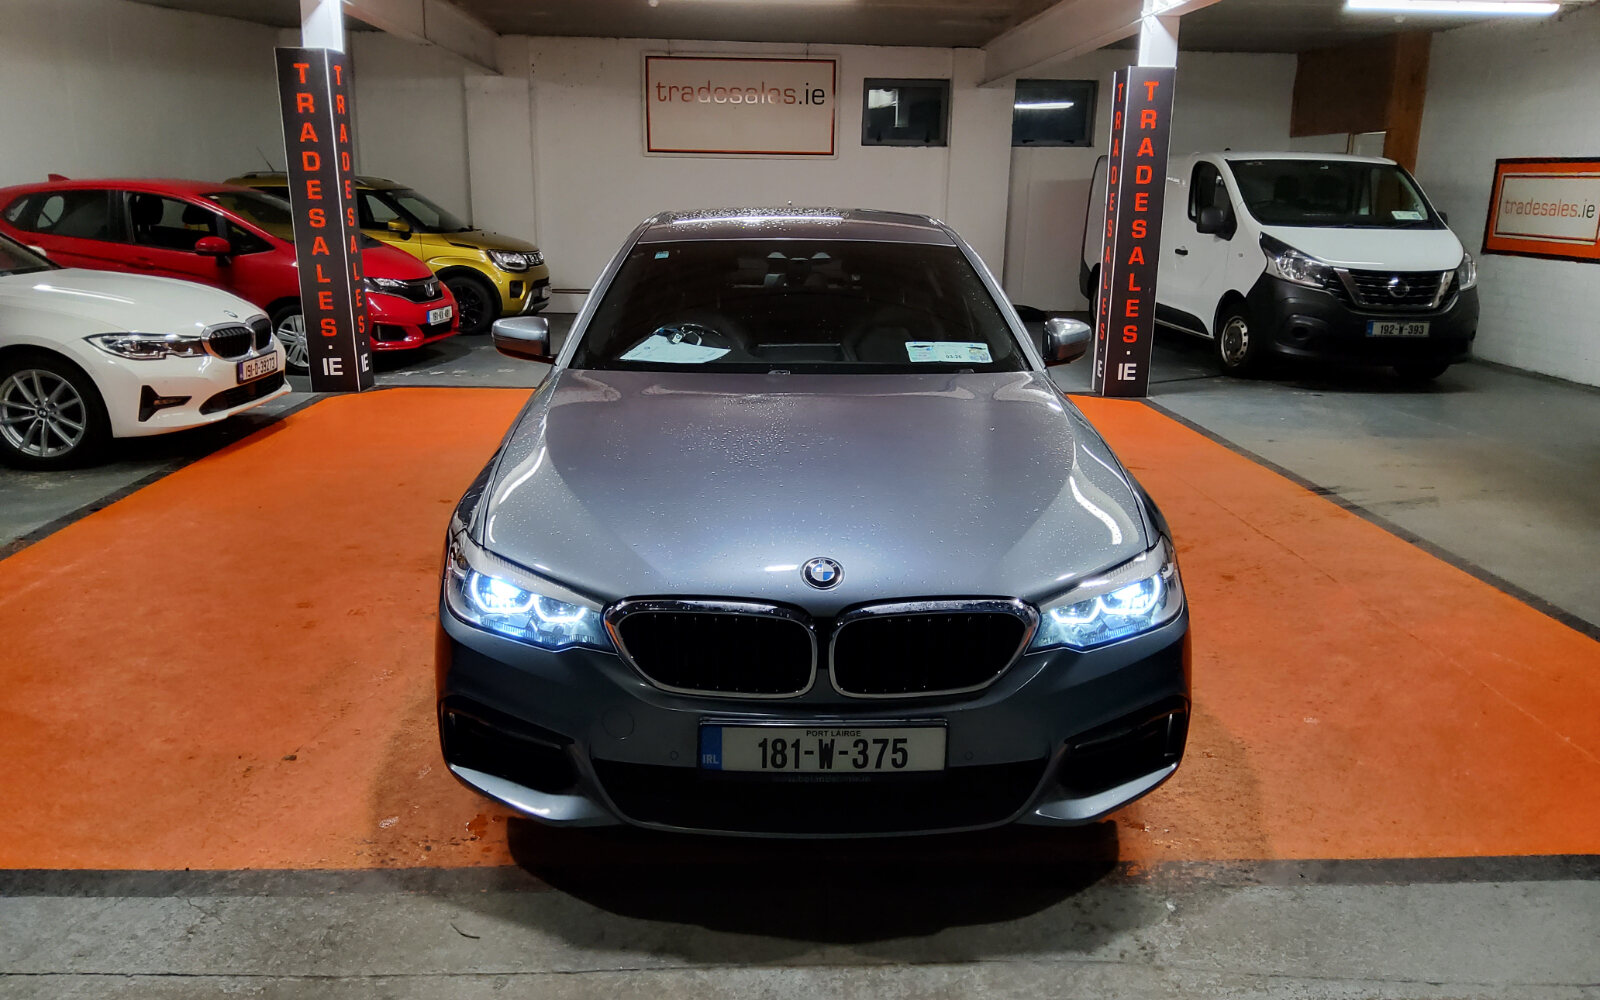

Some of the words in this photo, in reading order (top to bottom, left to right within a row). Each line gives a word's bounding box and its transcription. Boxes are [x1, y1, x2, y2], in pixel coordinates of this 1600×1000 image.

[655, 80, 826, 106] tradesales.ie
[1504, 198, 1596, 219] tradesales.ie
[806, 729, 828, 737] PORT
[702, 753, 720, 765] IRL
[757, 737, 909, 770] 181-W-375
